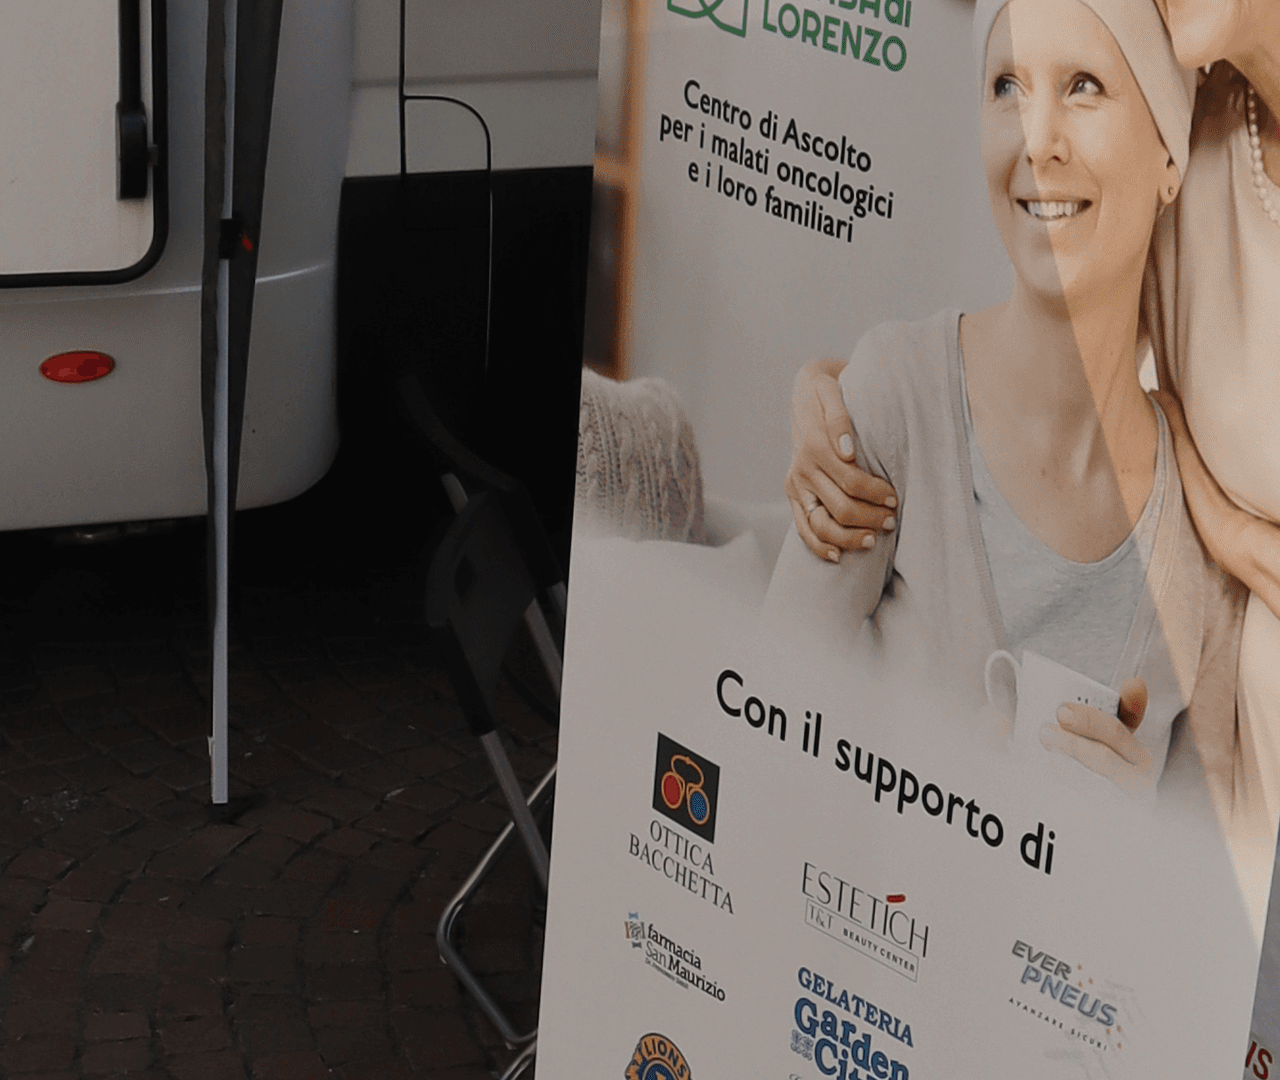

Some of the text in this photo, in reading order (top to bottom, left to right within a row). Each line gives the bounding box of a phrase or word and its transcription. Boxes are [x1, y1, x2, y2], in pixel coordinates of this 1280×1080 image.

[659, 113, 894, 219] per i malati oncologici
[683, 79, 872, 172] Centro di Ascolto
[687, 161, 854, 243] e i loro familiari
[716, 669, 1056, 875] Con il supporto di
[629, 832, 734, 915] BACCHETTA
[650, 819, 715, 876] OTTICA
[647, 923, 702, 971] farmacia
[802, 861, 929, 958] ESTETICH
[843, 927, 878, 952] BEAUTY
[880, 947, 916, 973] CENTER
[645, 940, 667, 968] San
[667, 954, 726, 1002] Maurizio
[1012, 939, 1072, 981] EVER
[1020, 964, 1118, 1027] PNEUS
[794, 997, 909, 1080] Garden
[797, 966, 914, 1048] GELATERIA
[1071, 1028, 1108, 1052] SICURI
